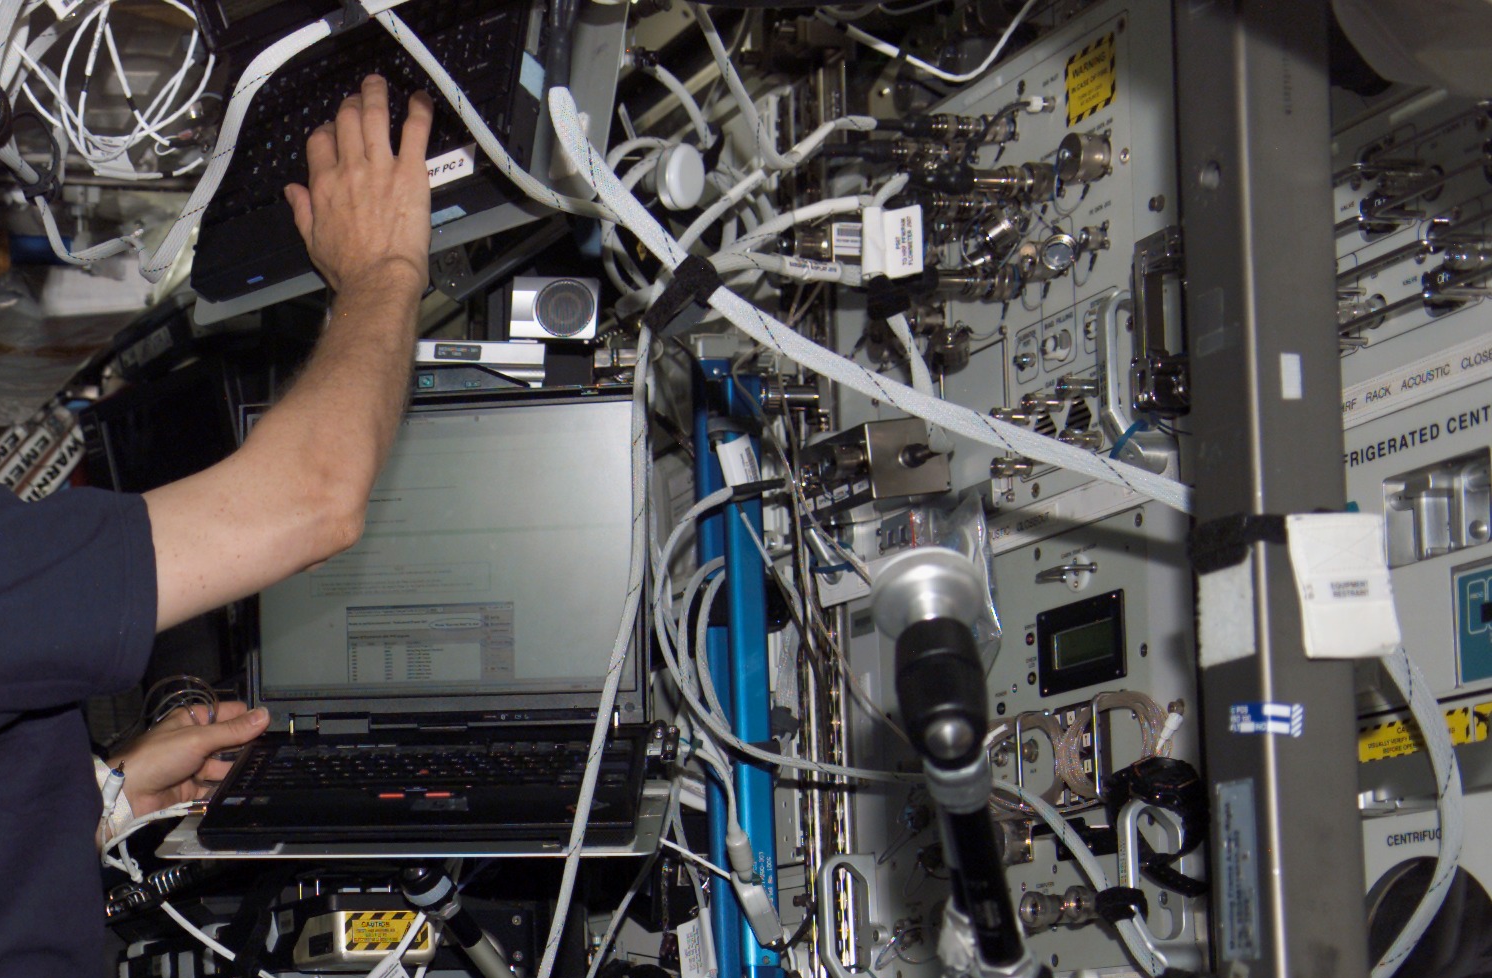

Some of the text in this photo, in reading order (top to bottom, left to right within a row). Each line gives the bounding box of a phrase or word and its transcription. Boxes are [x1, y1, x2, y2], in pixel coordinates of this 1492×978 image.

[1365, 386, 1392, 403] RACK
[1401, 363, 1451, 391] ACOUSTIC
[1447, 405, 1491, 434] CENT
